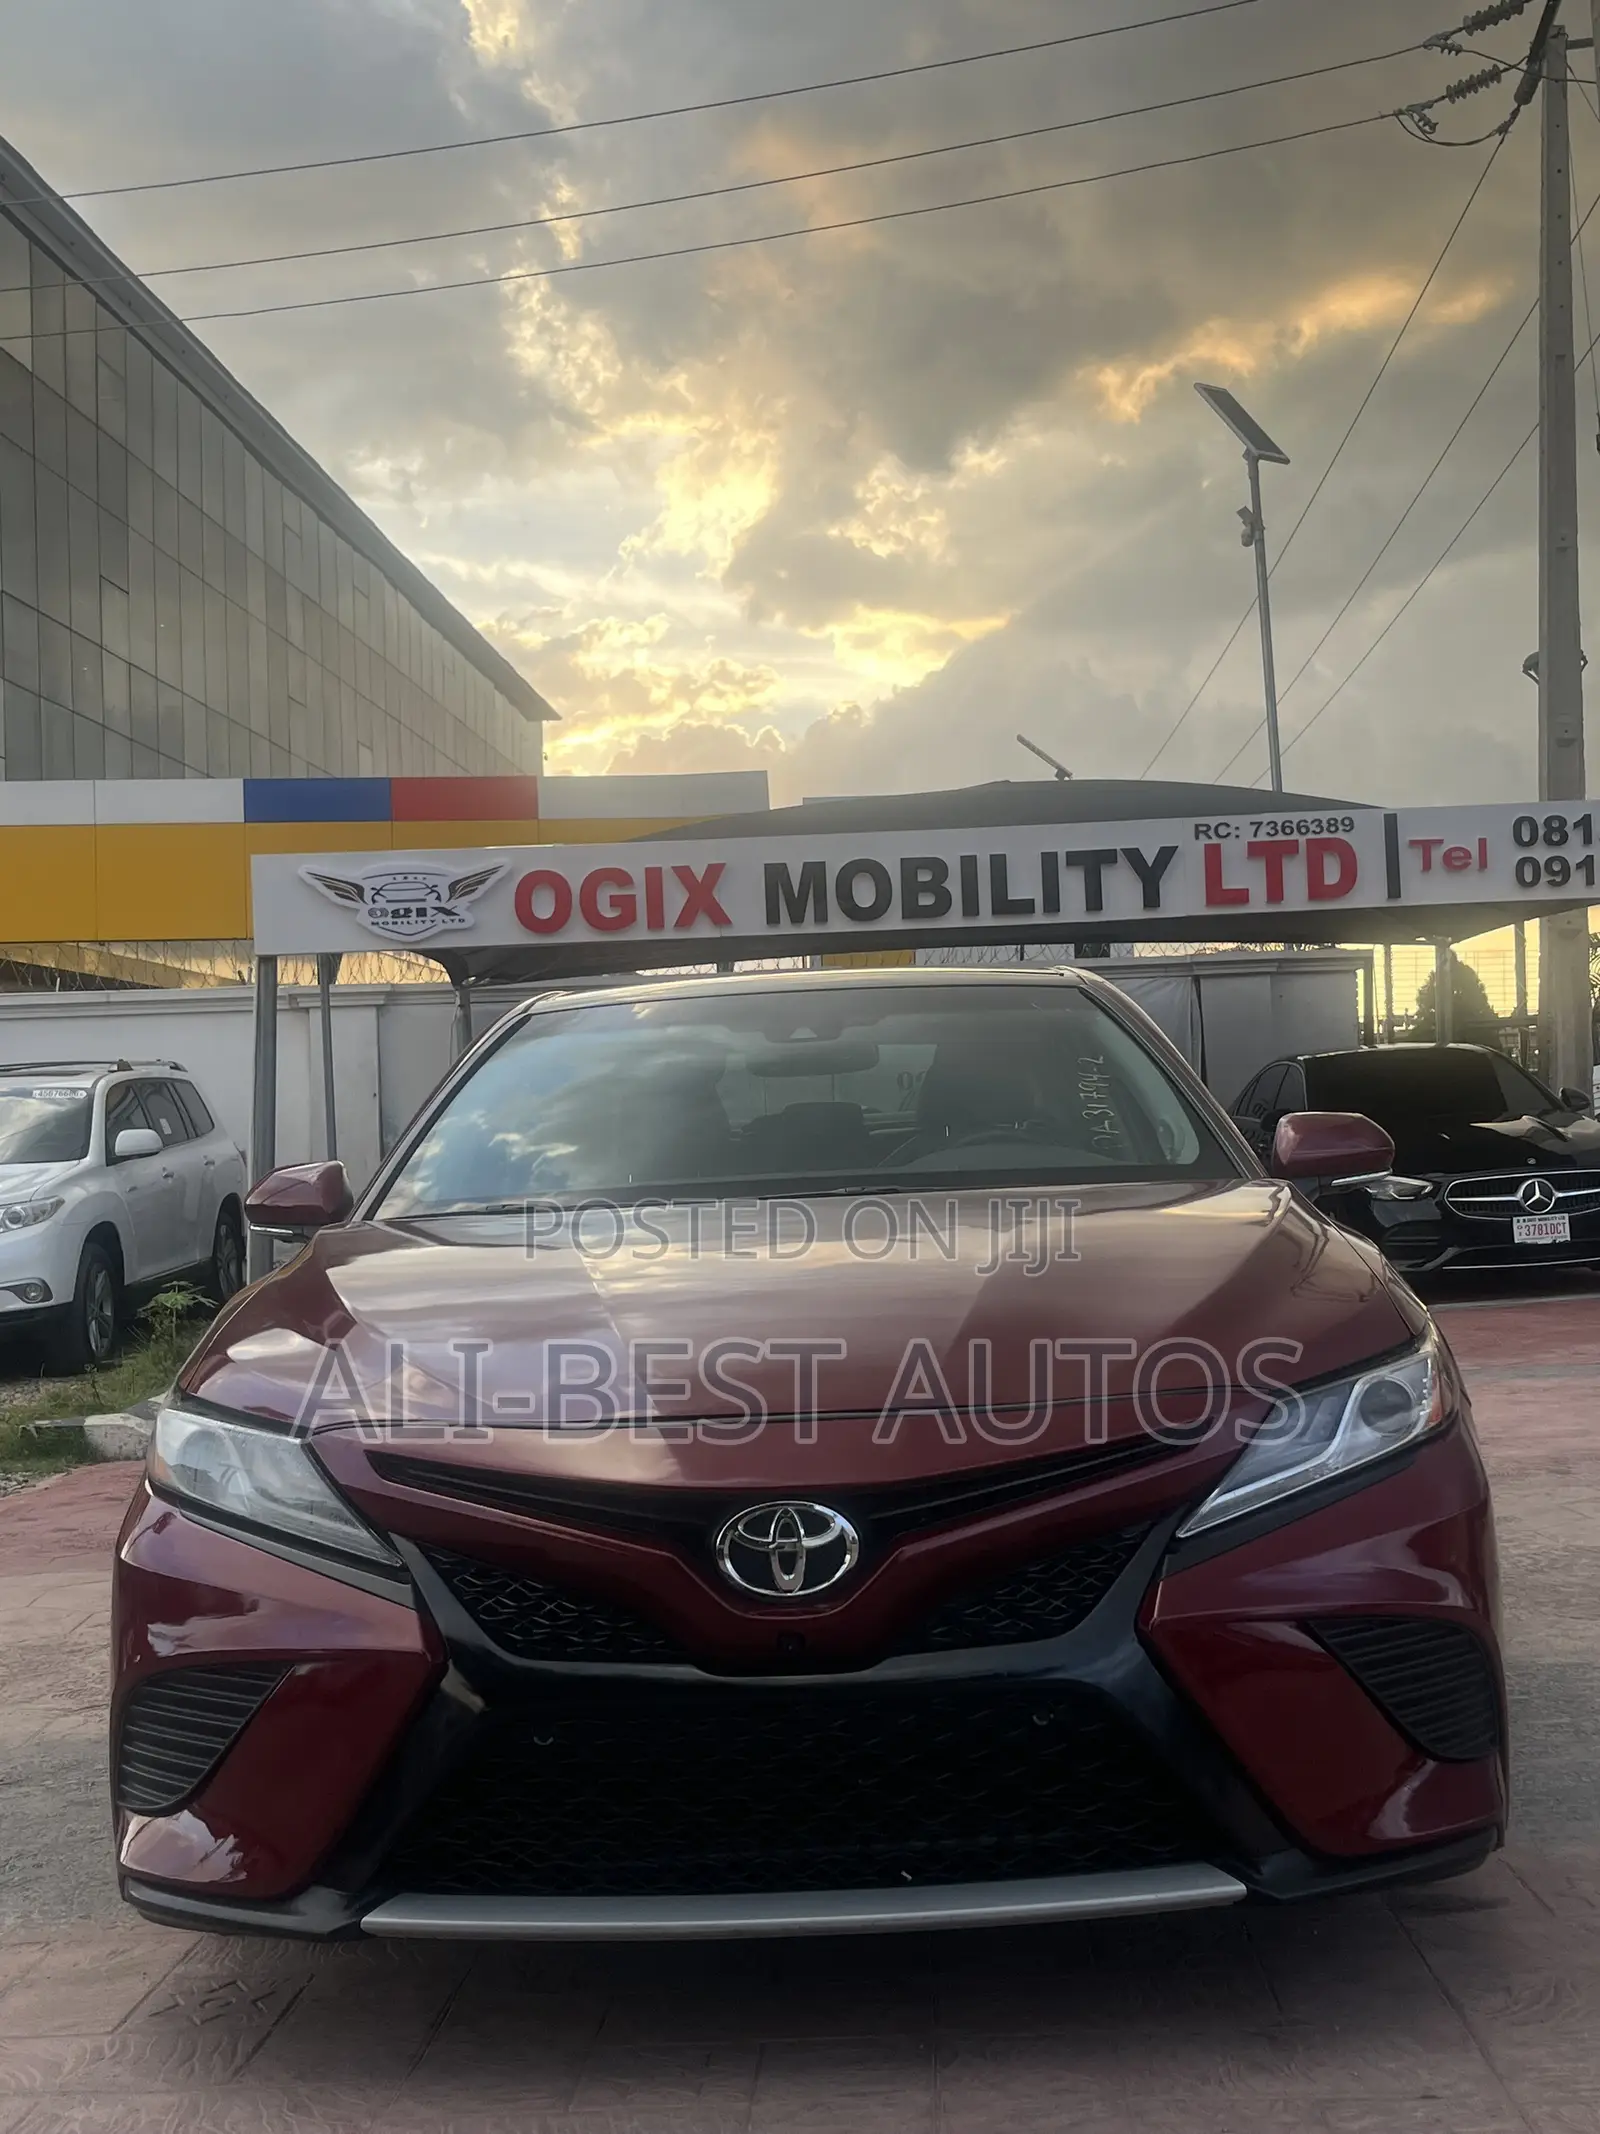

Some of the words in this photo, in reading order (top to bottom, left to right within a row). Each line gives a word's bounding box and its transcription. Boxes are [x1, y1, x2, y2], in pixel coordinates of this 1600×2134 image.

[1194, 821, 1240, 841] RC:
[1249, 816, 1355, 838] 7366389
[1512, 813, 1600, 847] 081
[1408, 837, 1488, 872] Tel
[1515, 854, 1596, 888] 091
[514, 862, 733, 934] OGIX
[764, 845, 1179, 926] MOBILITY
[1204, 837, 1358, 907] LTD
